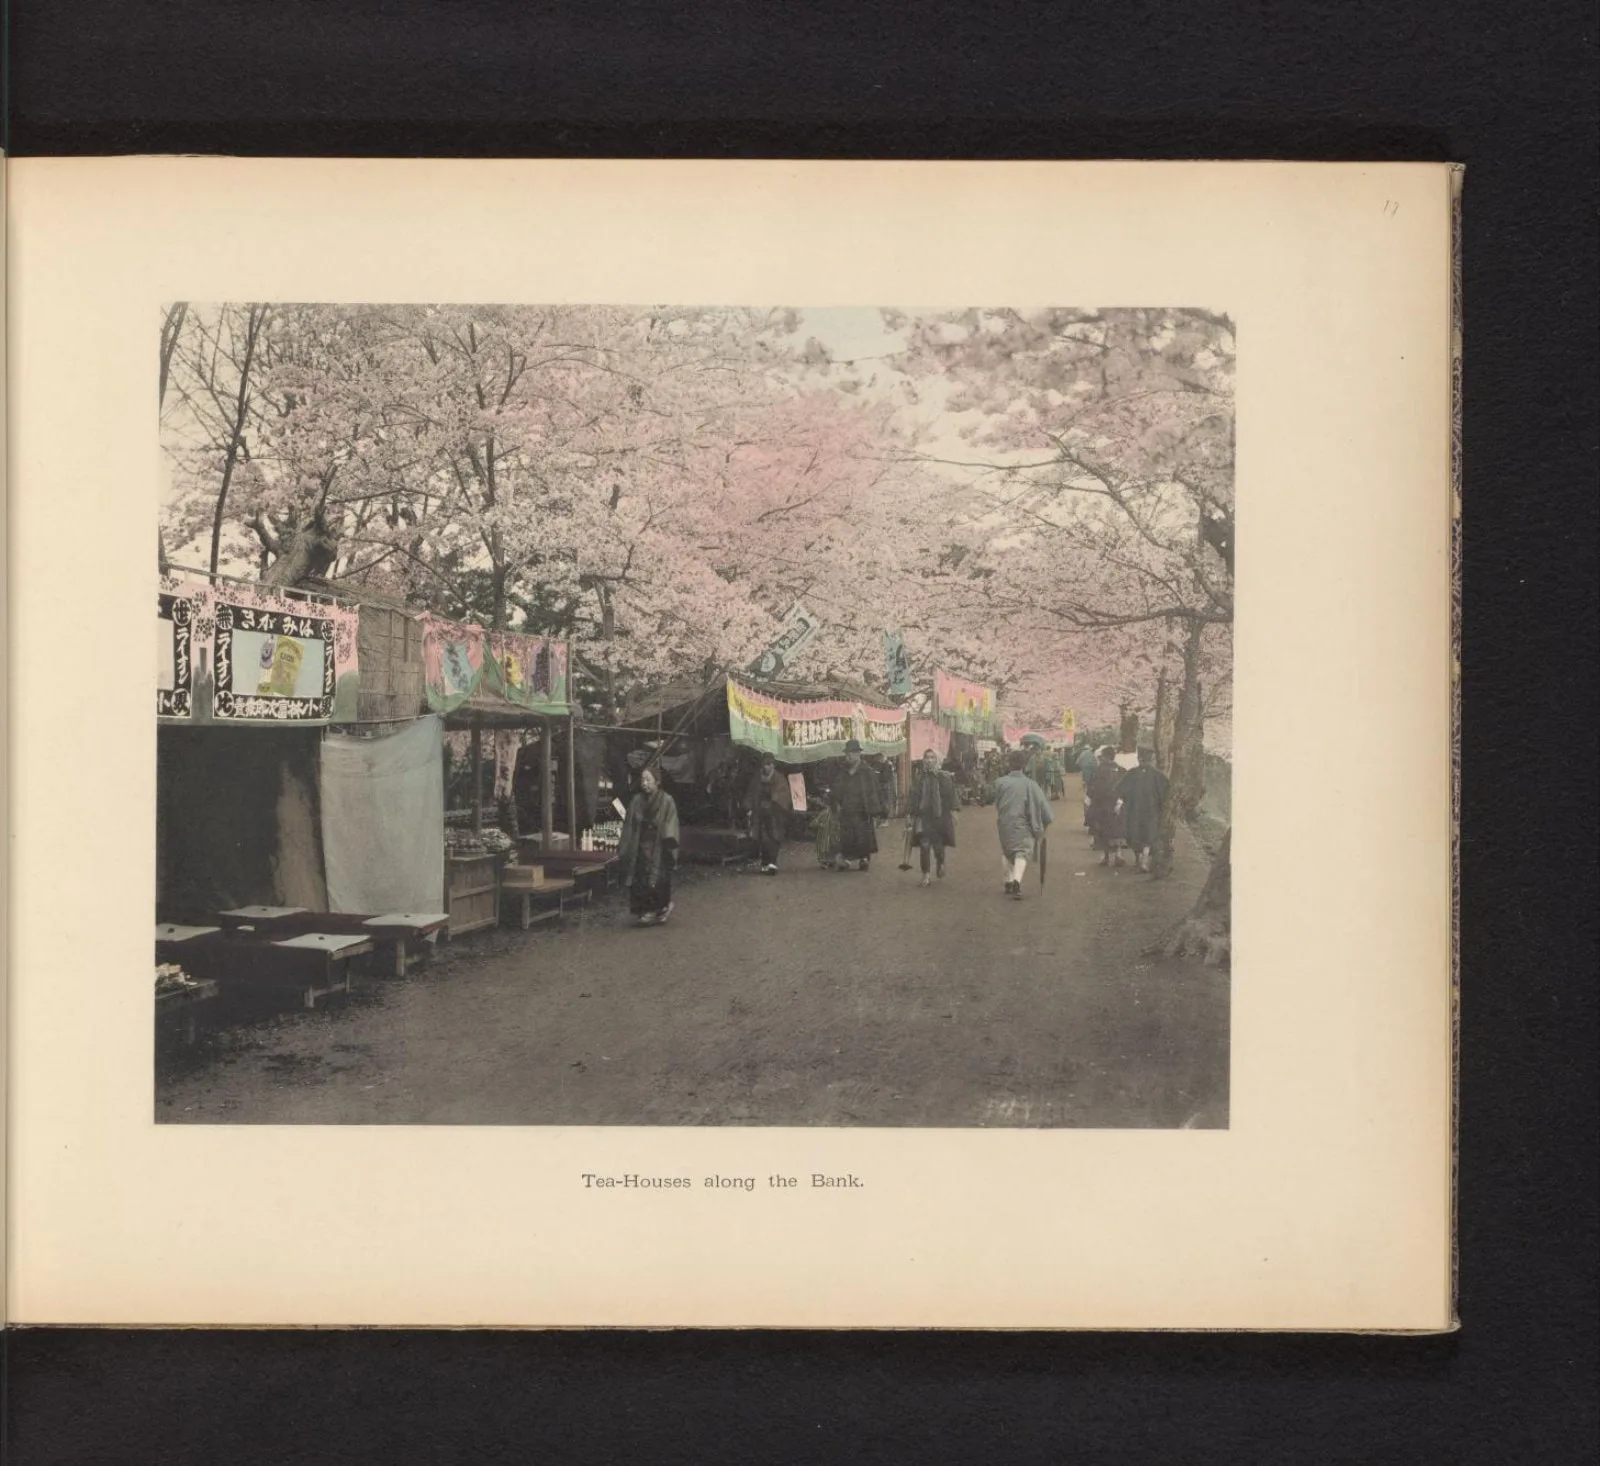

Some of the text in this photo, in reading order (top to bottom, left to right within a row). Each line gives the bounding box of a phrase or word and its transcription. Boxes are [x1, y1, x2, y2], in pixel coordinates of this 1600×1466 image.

[216, 634, 231, 688] ライオン
[581, 1173, 864, 1192] Tea-Houses along the Bank.
